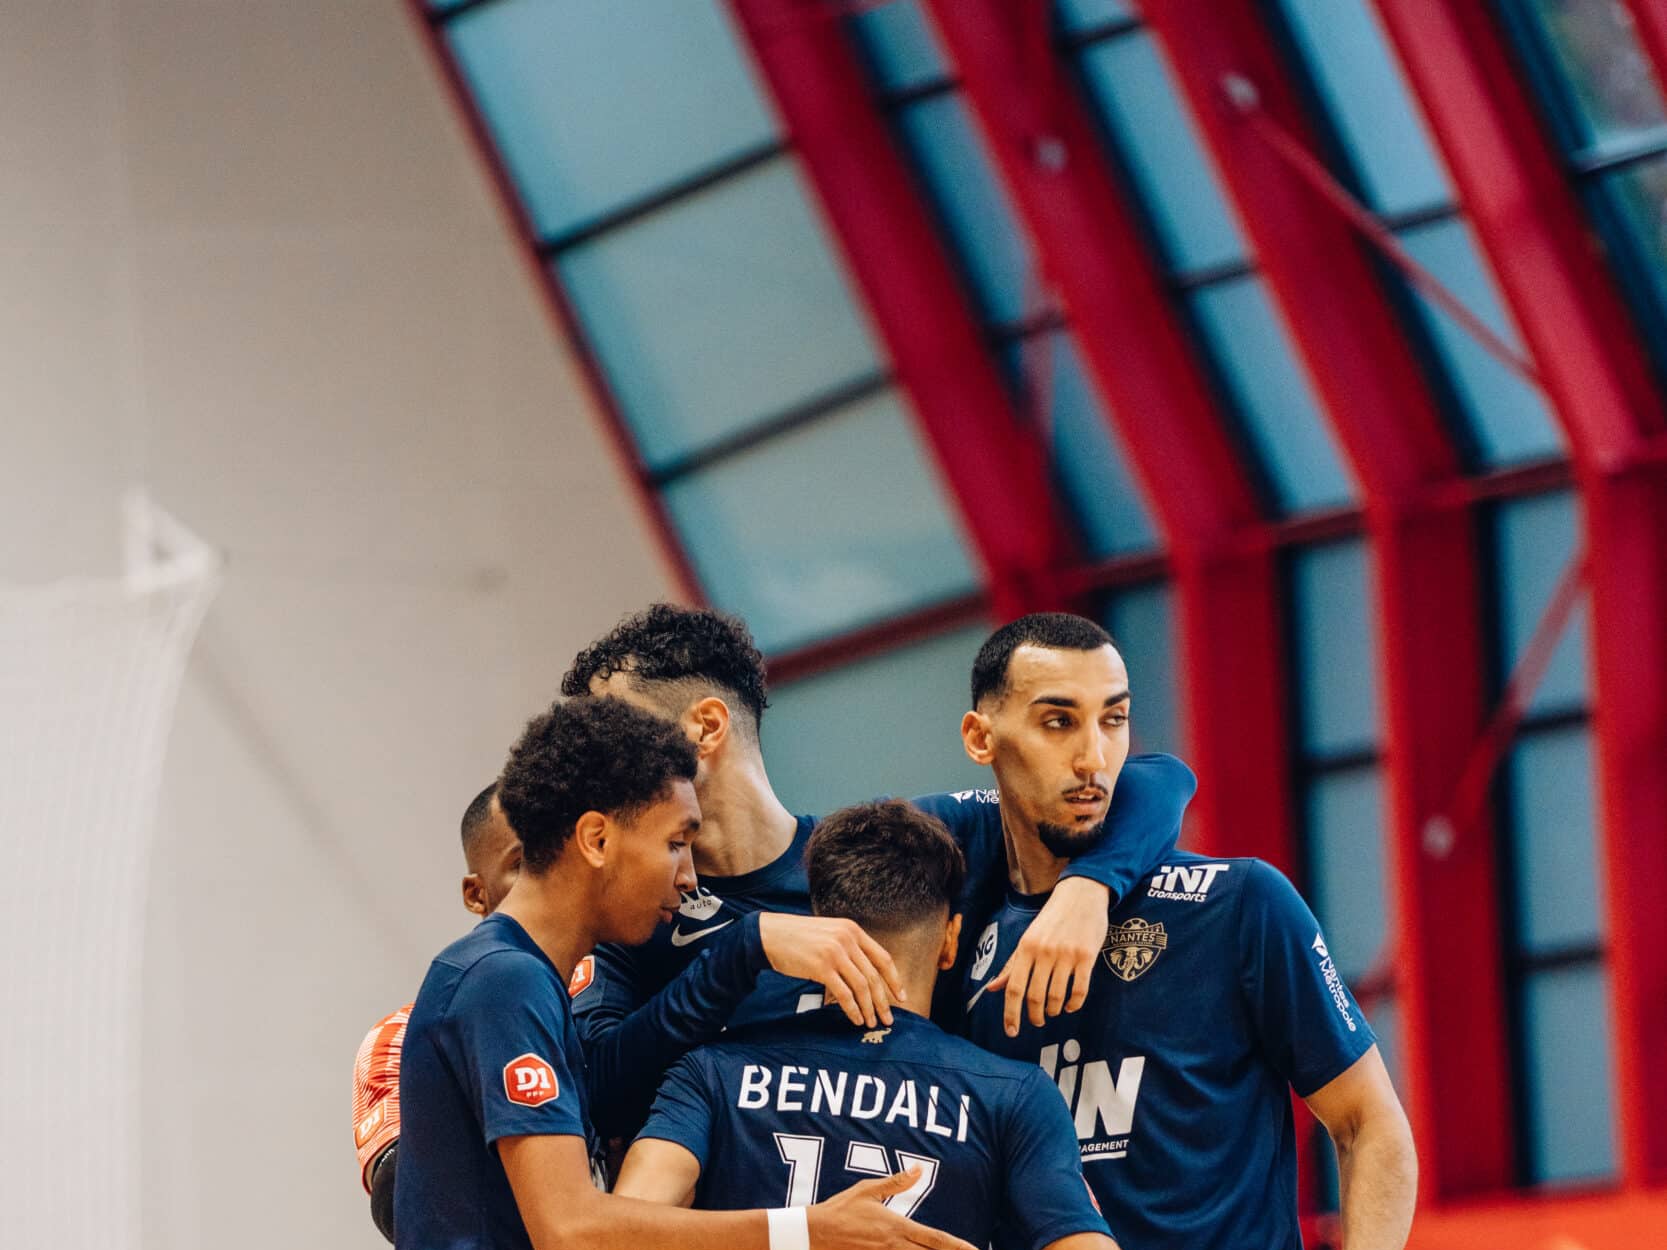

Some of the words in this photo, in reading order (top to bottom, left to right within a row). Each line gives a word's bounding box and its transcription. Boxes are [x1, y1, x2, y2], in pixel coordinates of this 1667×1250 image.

[1147, 887, 1207, 902] transports
[690, 899, 712, 910] auto
[1110, 933, 1156, 944] NANTES
[1327, 956, 1350, 1009] Nantes
[514, 1067, 552, 1091] D1
[737, 1064, 971, 1143] BENDALI
[1079, 1139, 1129, 1153] AGEMENT
